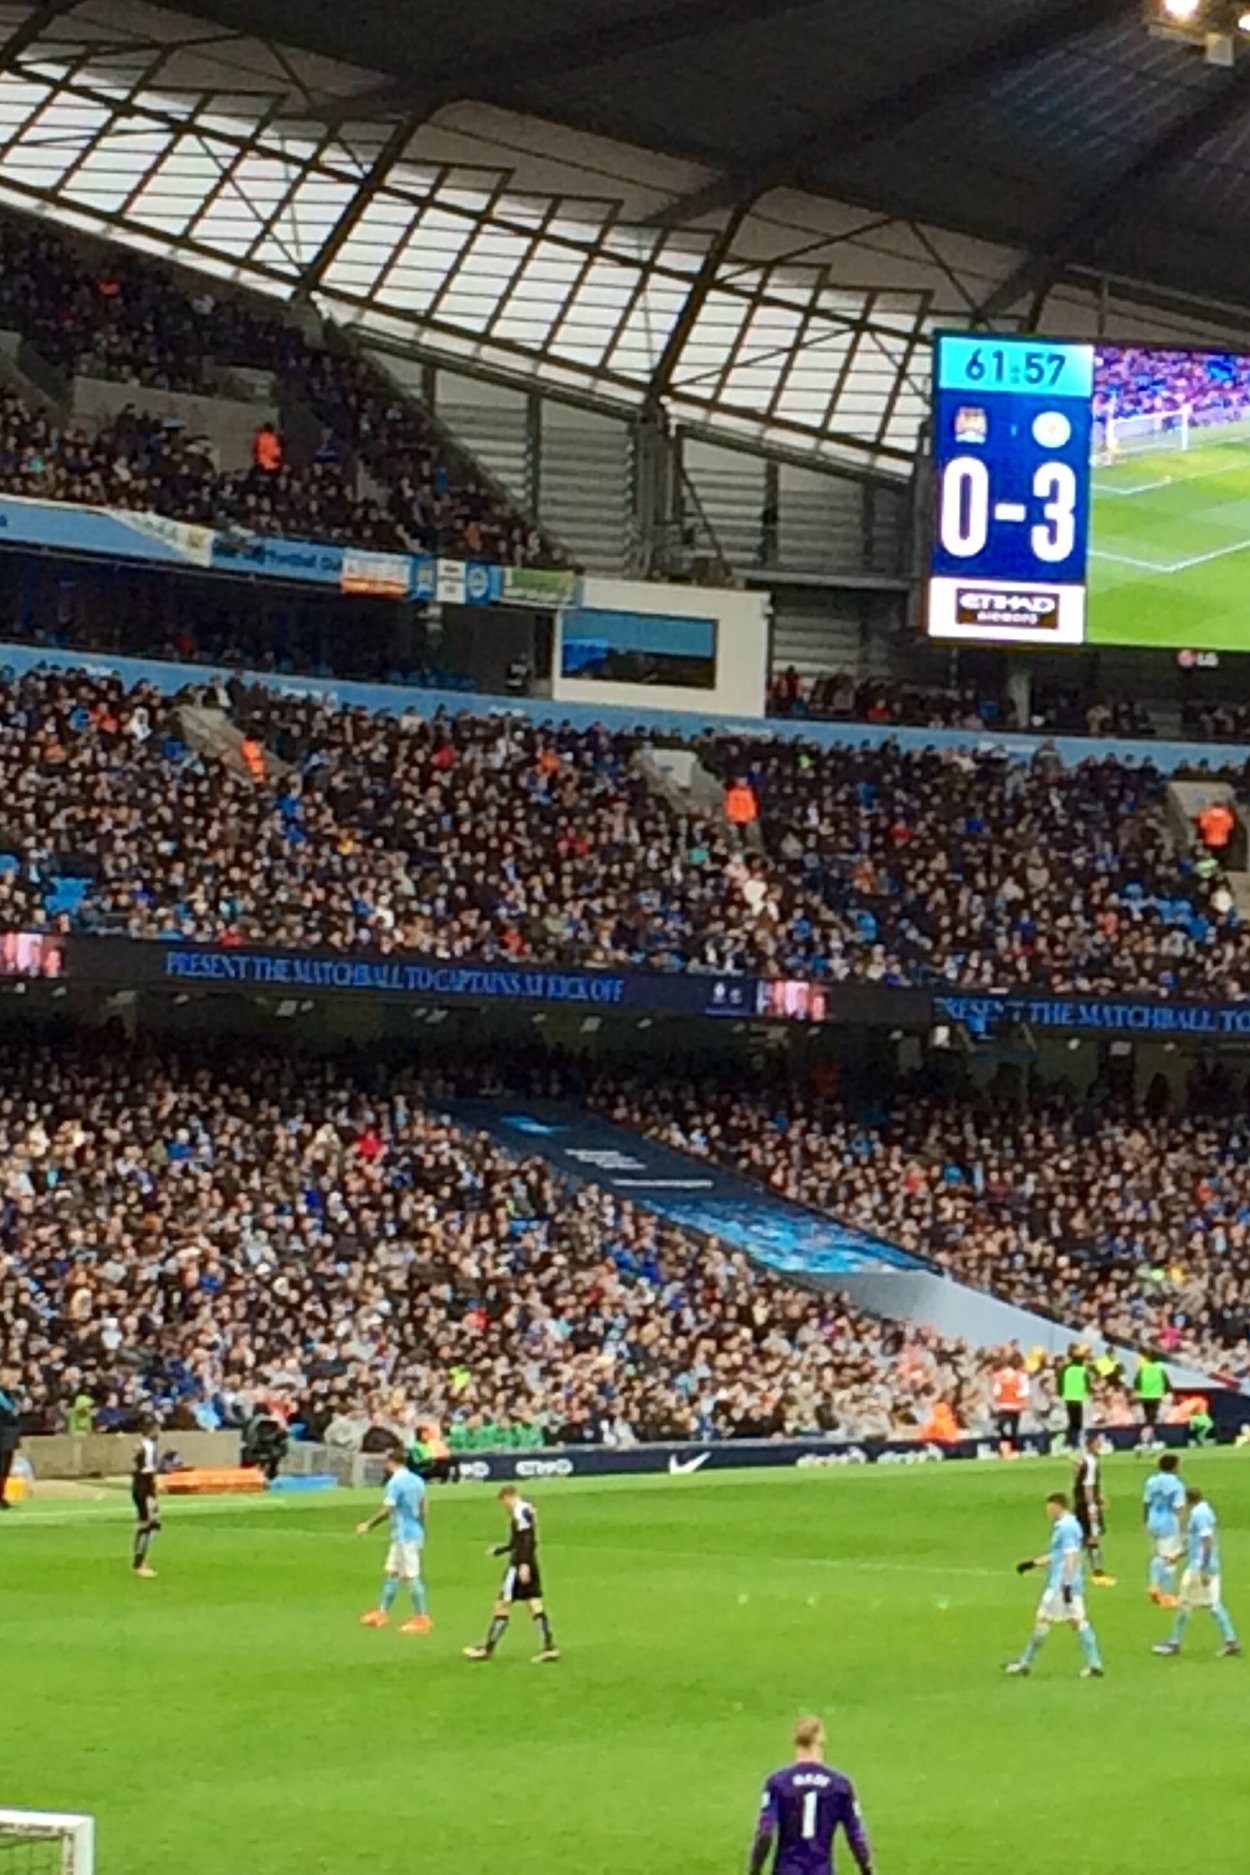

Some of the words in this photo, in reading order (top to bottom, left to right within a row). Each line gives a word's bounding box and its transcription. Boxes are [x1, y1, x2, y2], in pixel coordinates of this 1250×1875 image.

[965, 347, 1067, 387] 61:57
[1028, 1001, 1074, 1025] THE
[802, 1790, 818, 1839] 1
